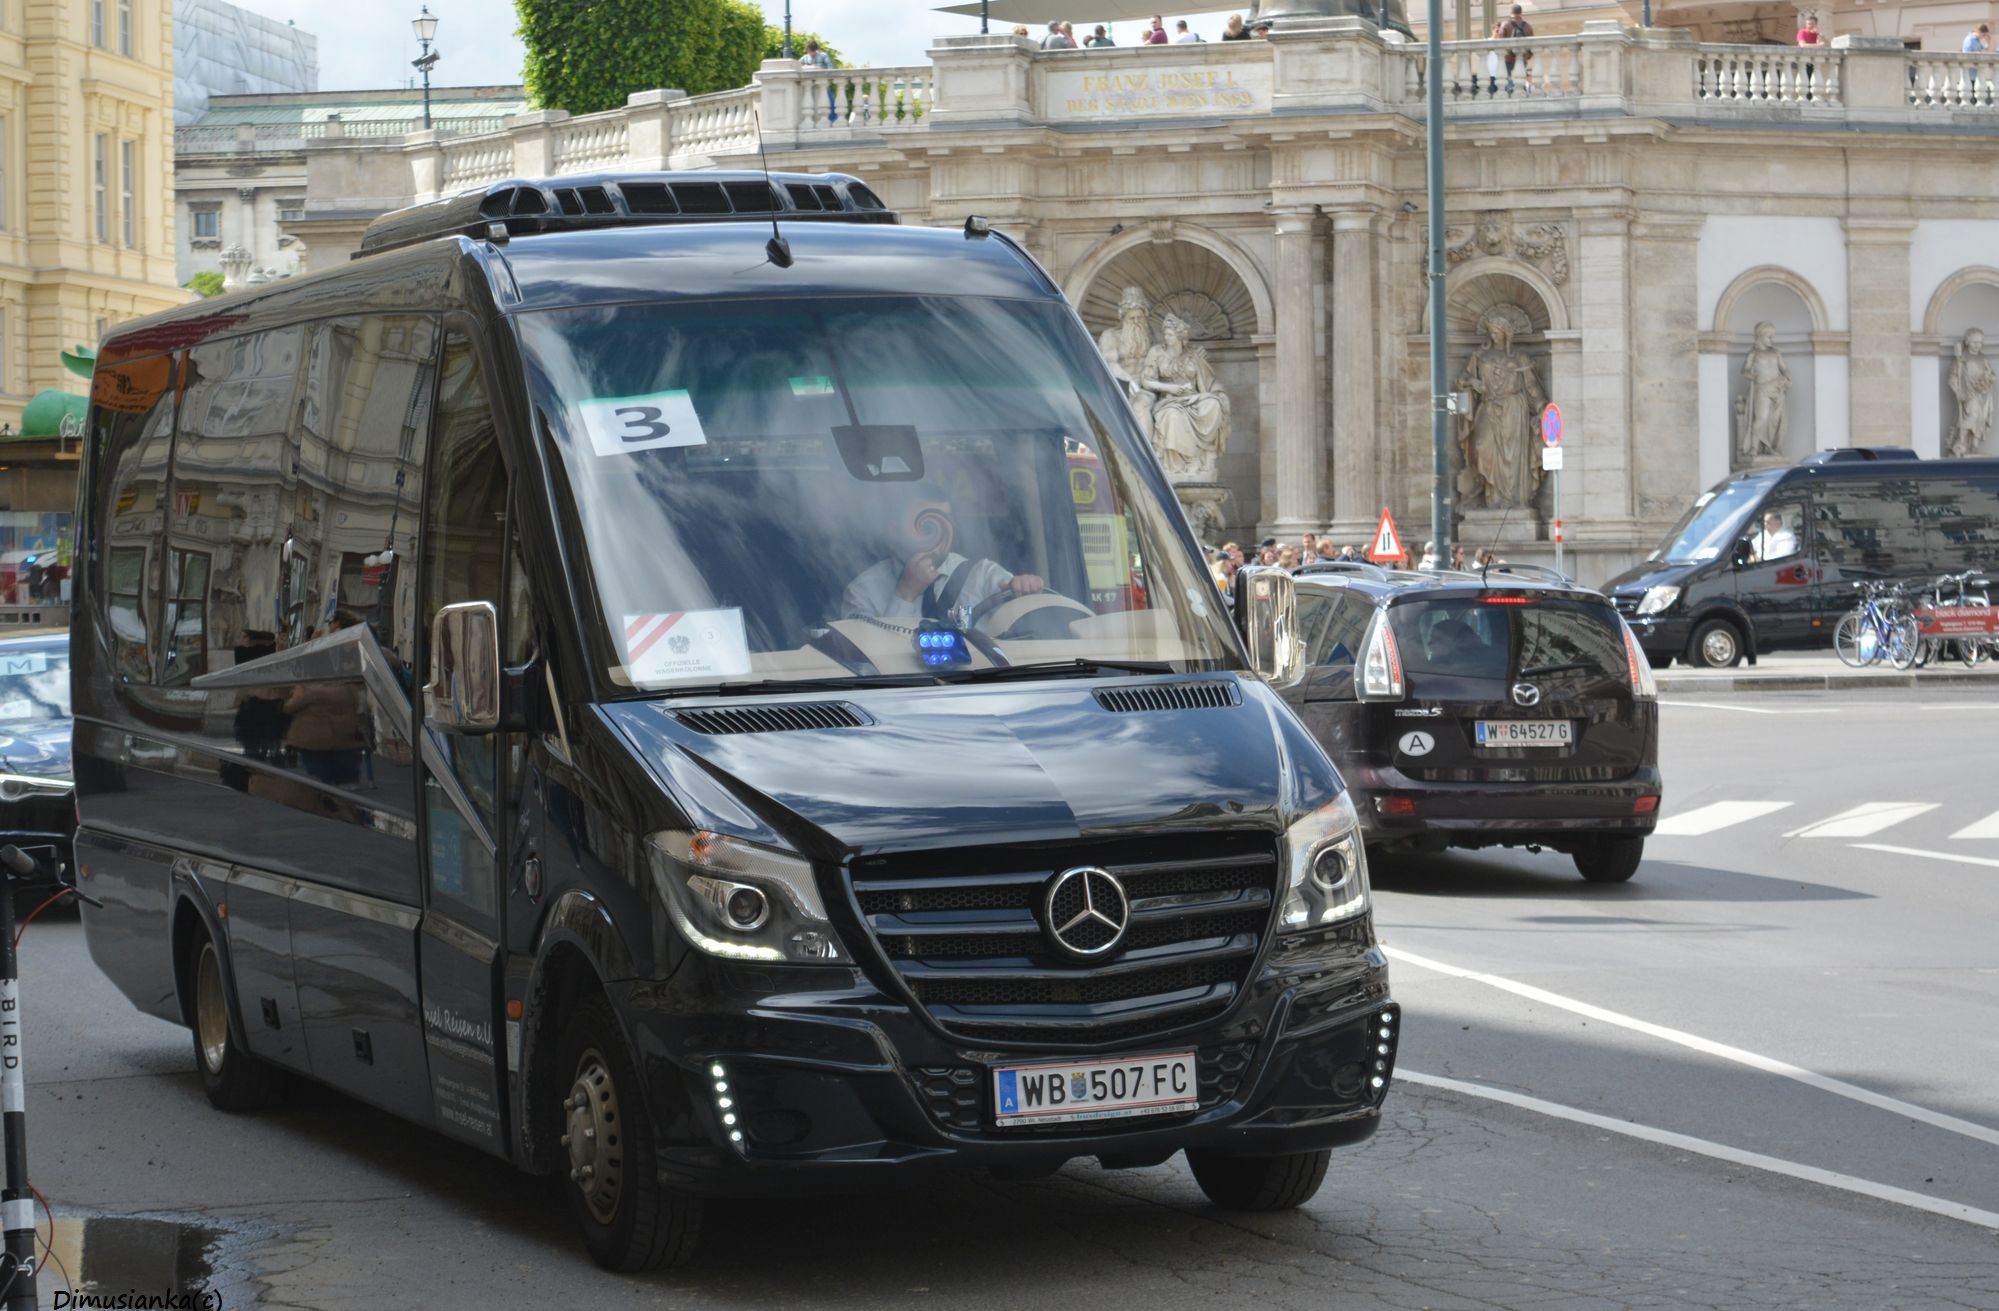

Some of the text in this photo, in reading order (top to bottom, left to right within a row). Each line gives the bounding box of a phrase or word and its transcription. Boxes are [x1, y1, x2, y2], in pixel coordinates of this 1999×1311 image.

[1083, 73, 1150, 96] FRANZ
[1160, 71, 1217, 90] JOSEF
[1066, 98, 1099, 112] DER
[1165, 94, 1208, 109] WIEN
[614, 406, 671, 443] 3
[7, 660, 32, 674] M
[1488, 724, 1568, 739] W 64527 G
[1408, 734, 1426, 752] A
[2, 998, 18, 1069] BIRD
[1022, 1062, 1187, 1107] WB 507 FC
[1004, 1098, 1014, 1108] A
